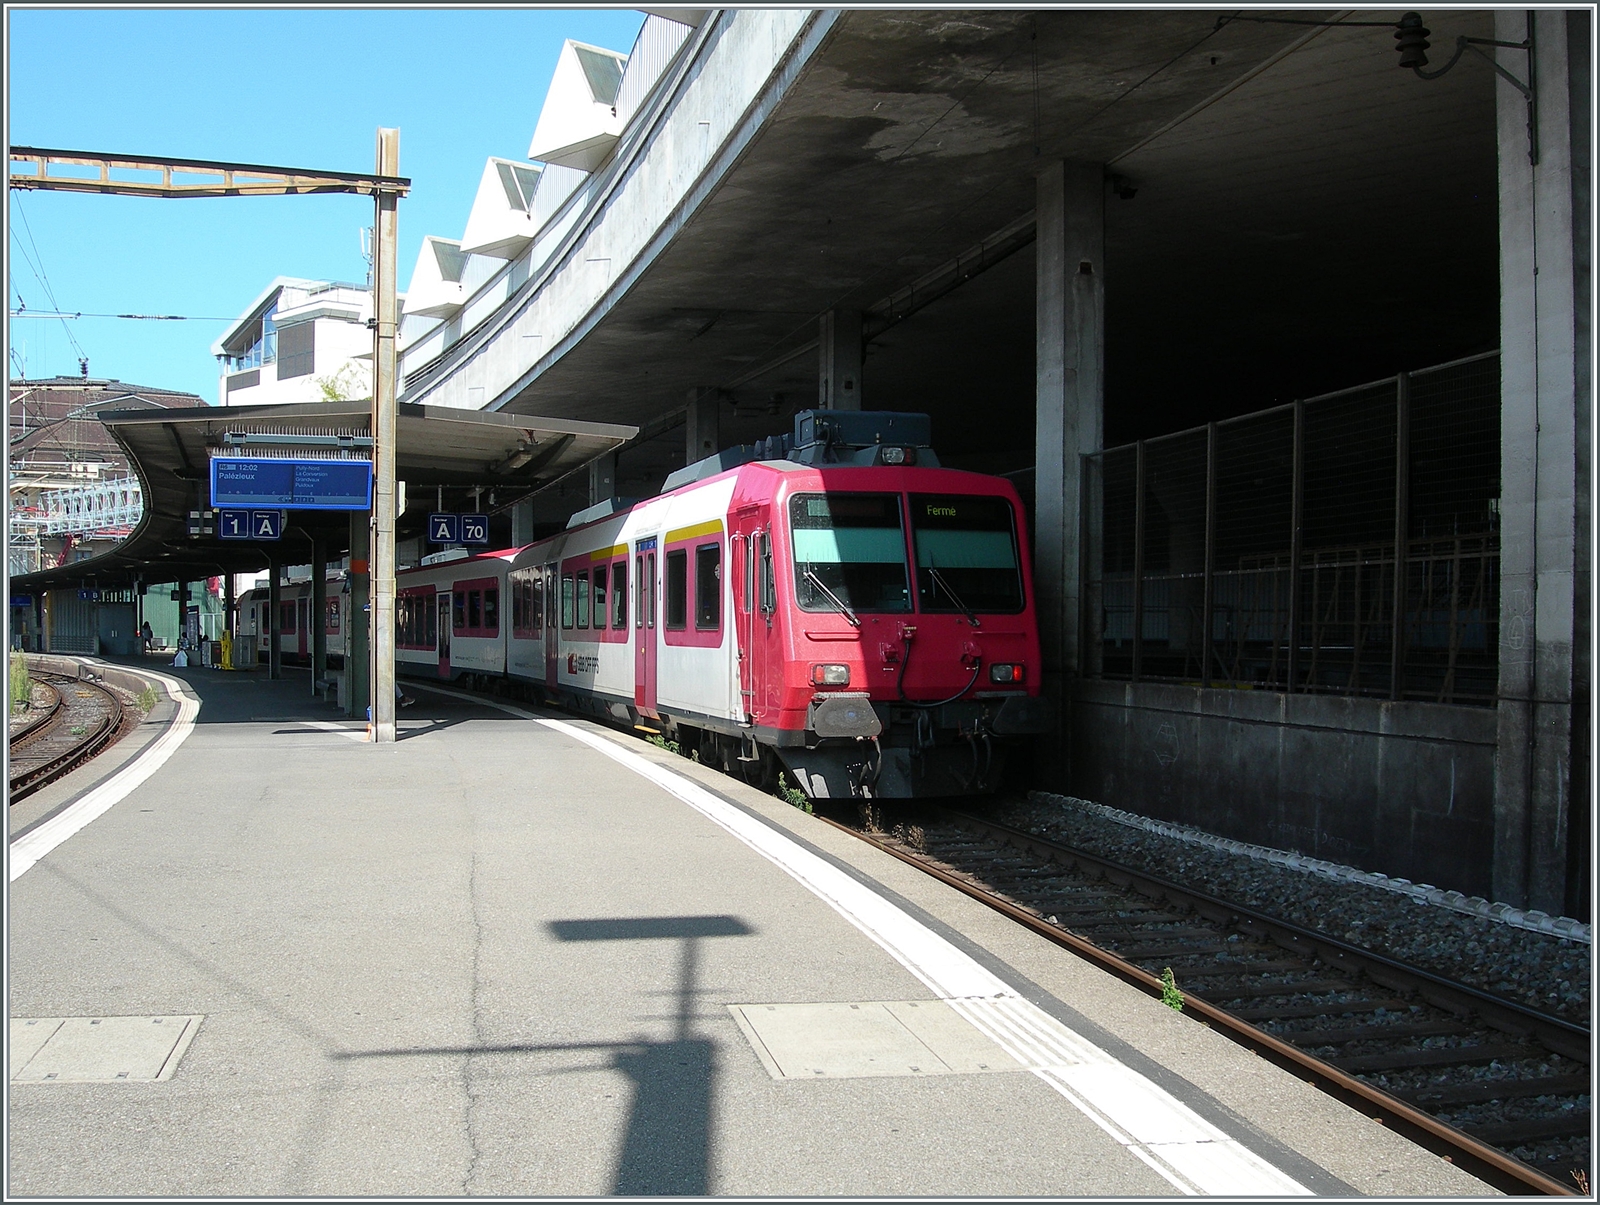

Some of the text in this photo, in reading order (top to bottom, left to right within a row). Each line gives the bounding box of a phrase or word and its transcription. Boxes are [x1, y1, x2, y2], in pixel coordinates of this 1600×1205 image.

[218, 472, 255, 480] Palézieux
[927, 504, 956, 516] Fermé
[230, 518, 238, 534] 1
[259, 519, 273, 534] A
[436, 523, 450, 538] A
[466, 525, 484, 539] 70
